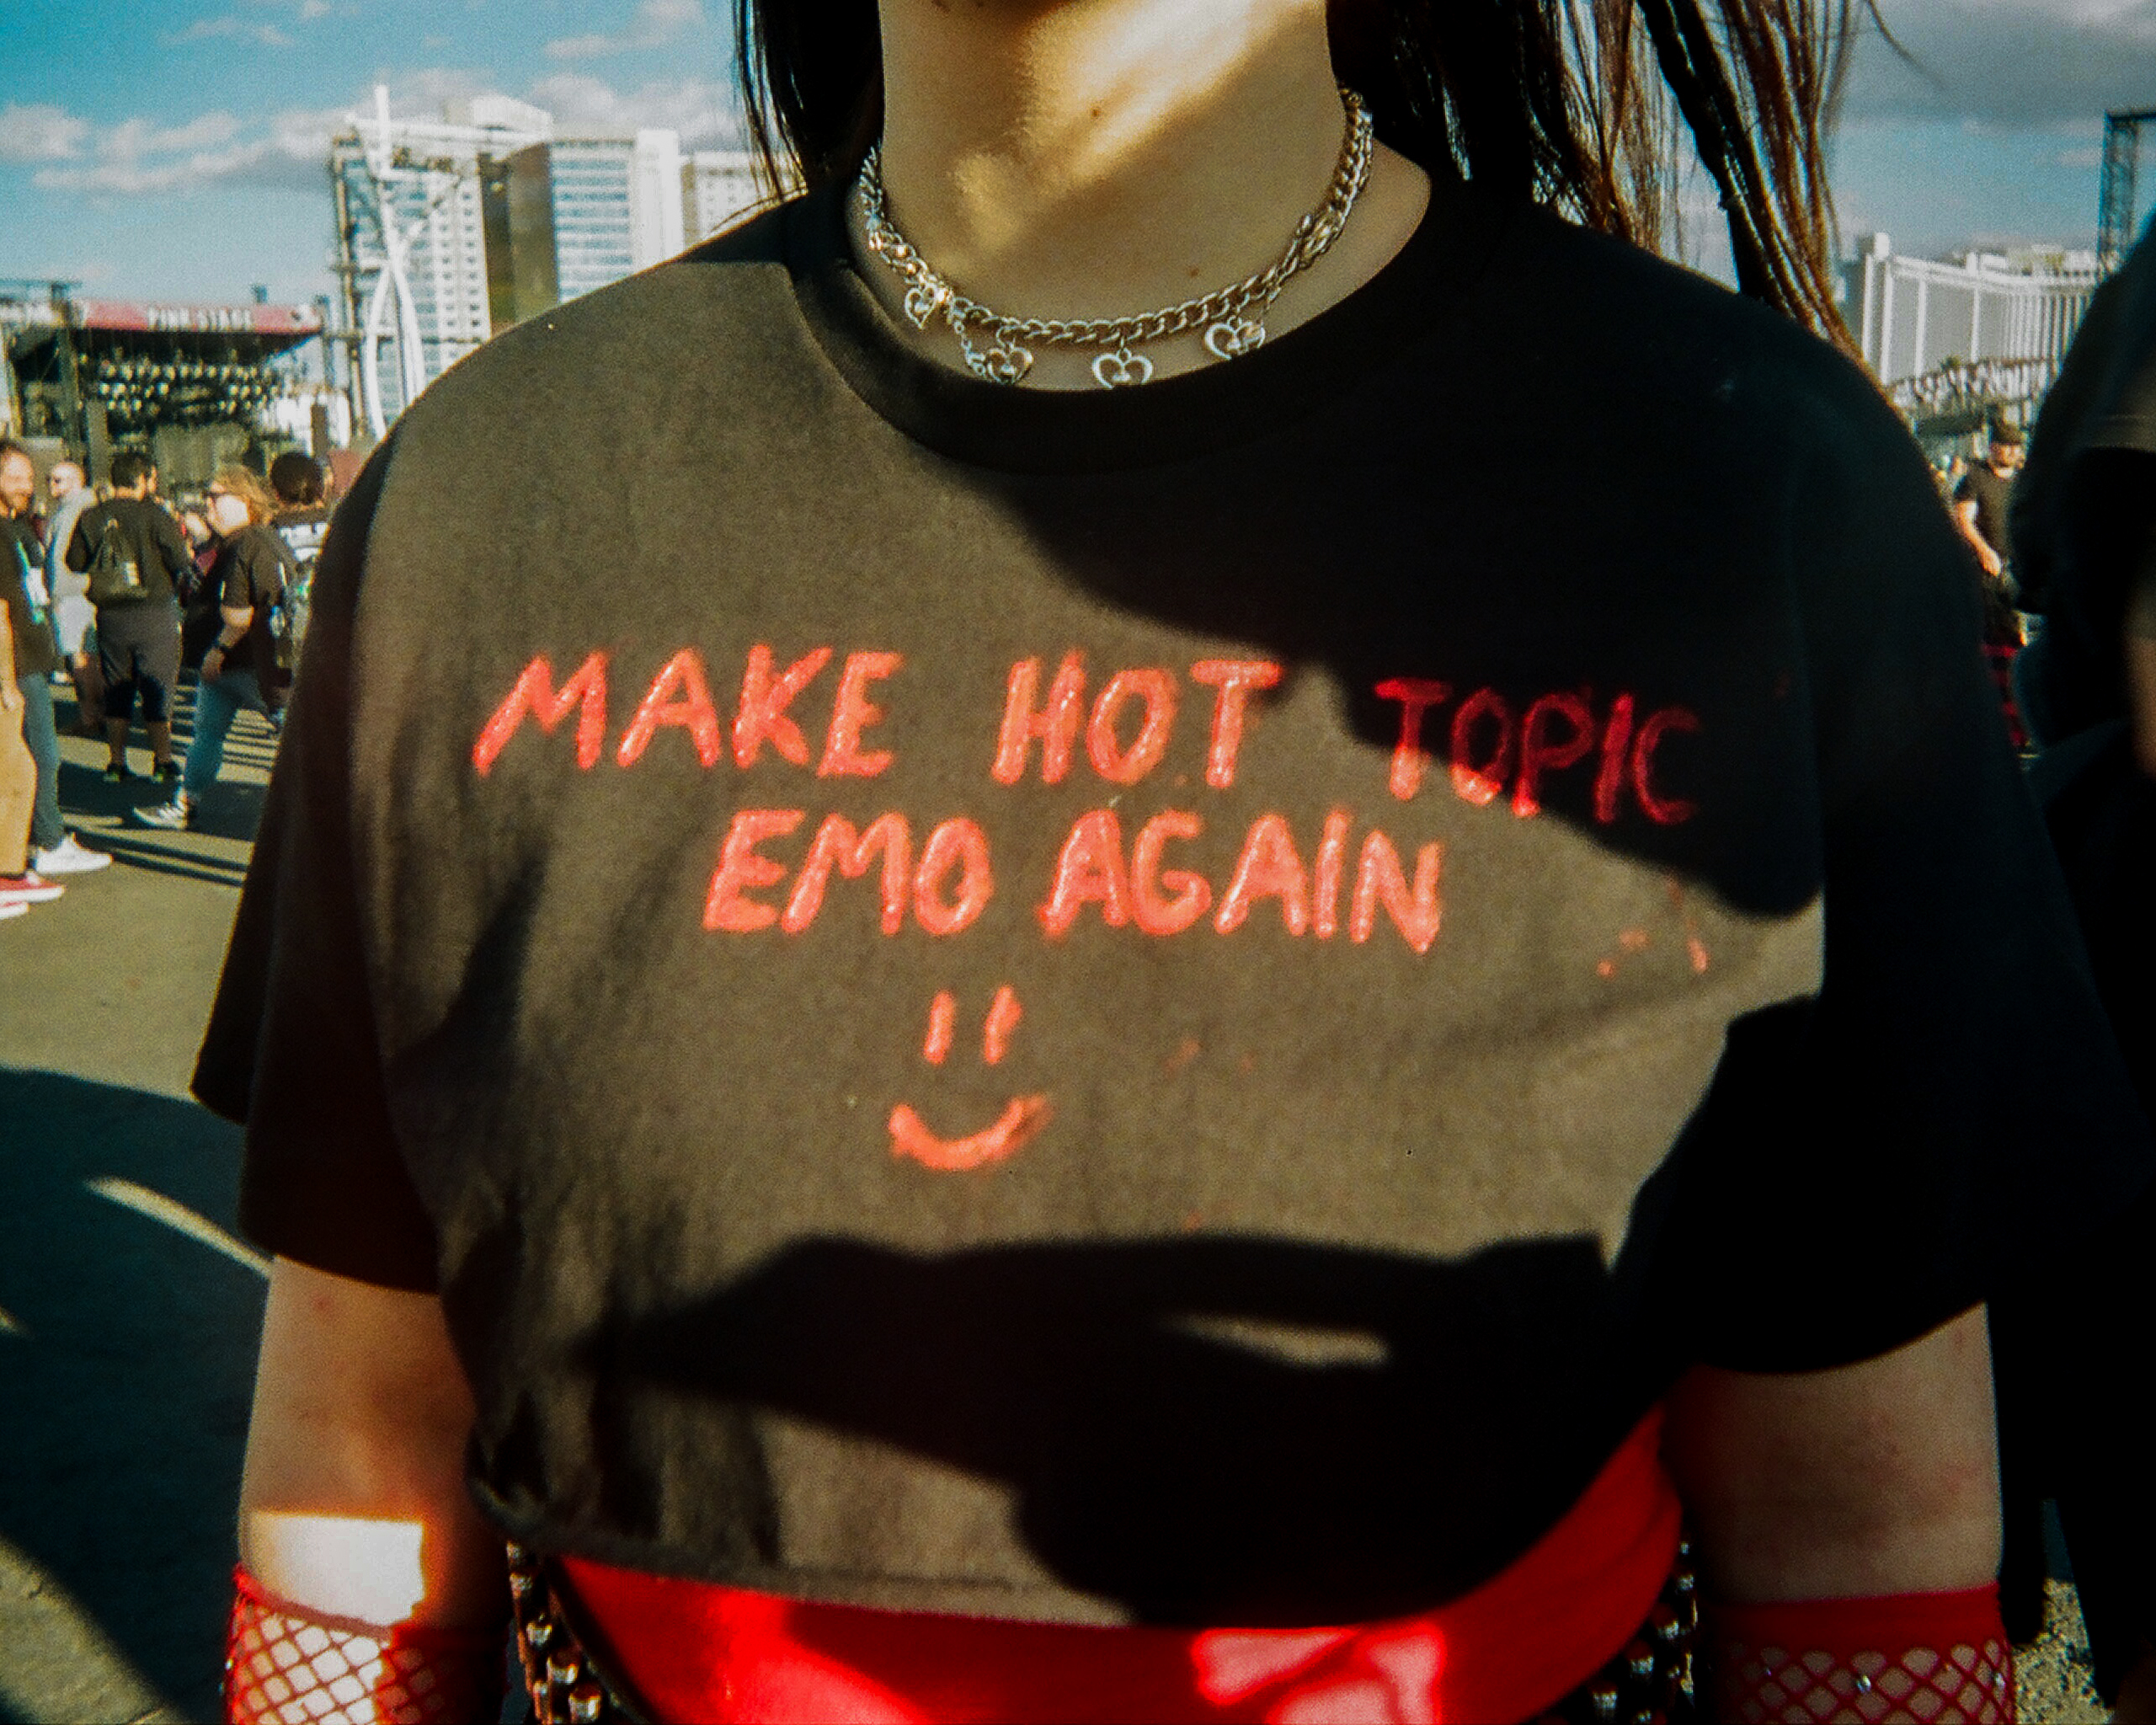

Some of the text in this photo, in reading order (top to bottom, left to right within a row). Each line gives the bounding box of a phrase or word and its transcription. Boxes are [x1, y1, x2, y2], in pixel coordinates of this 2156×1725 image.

[472, 644, 1705, 825] MAKE HOT TOPIC
[702, 806, 1446, 954] EMO AGAIN
